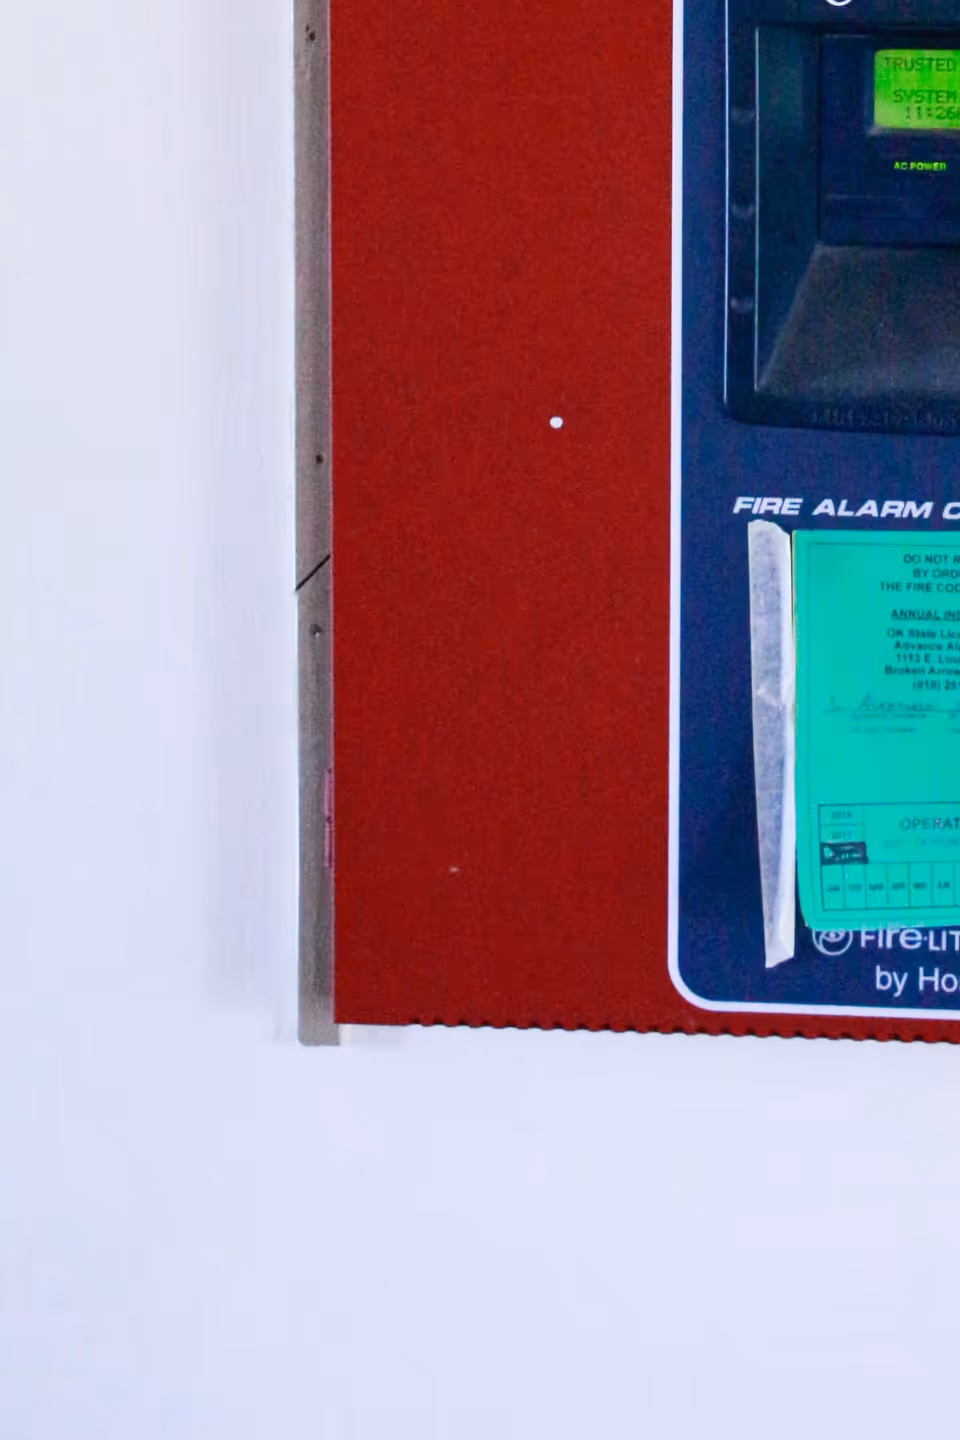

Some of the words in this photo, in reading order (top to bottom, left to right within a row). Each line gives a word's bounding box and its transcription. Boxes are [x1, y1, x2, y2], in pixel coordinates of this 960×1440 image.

[884, 56, 957, 73] TRUSTED
[893, 89, 957, 105] SYSTEM
[894, 162, 908, 171] AC
[909, 162, 947, 172] POWER
[733, 496, 803, 515] FIRE
[812, 498, 934, 519] ALARM
[903, 554, 921, 564] DO
[924, 554, 949, 564] NOT
[913, 568, 928, 578] BY
[880, 582, 901, 592] THE
[906, 583, 932, 593] FIRE
[891, 609, 940, 620] ANNUAL
[886, 629, 904, 638] OK
[907, 629, 936, 639] State
[894, 641, 943, 651] Advance
[884, 665, 926, 675] Broken
[875, 965, 908, 997] by
